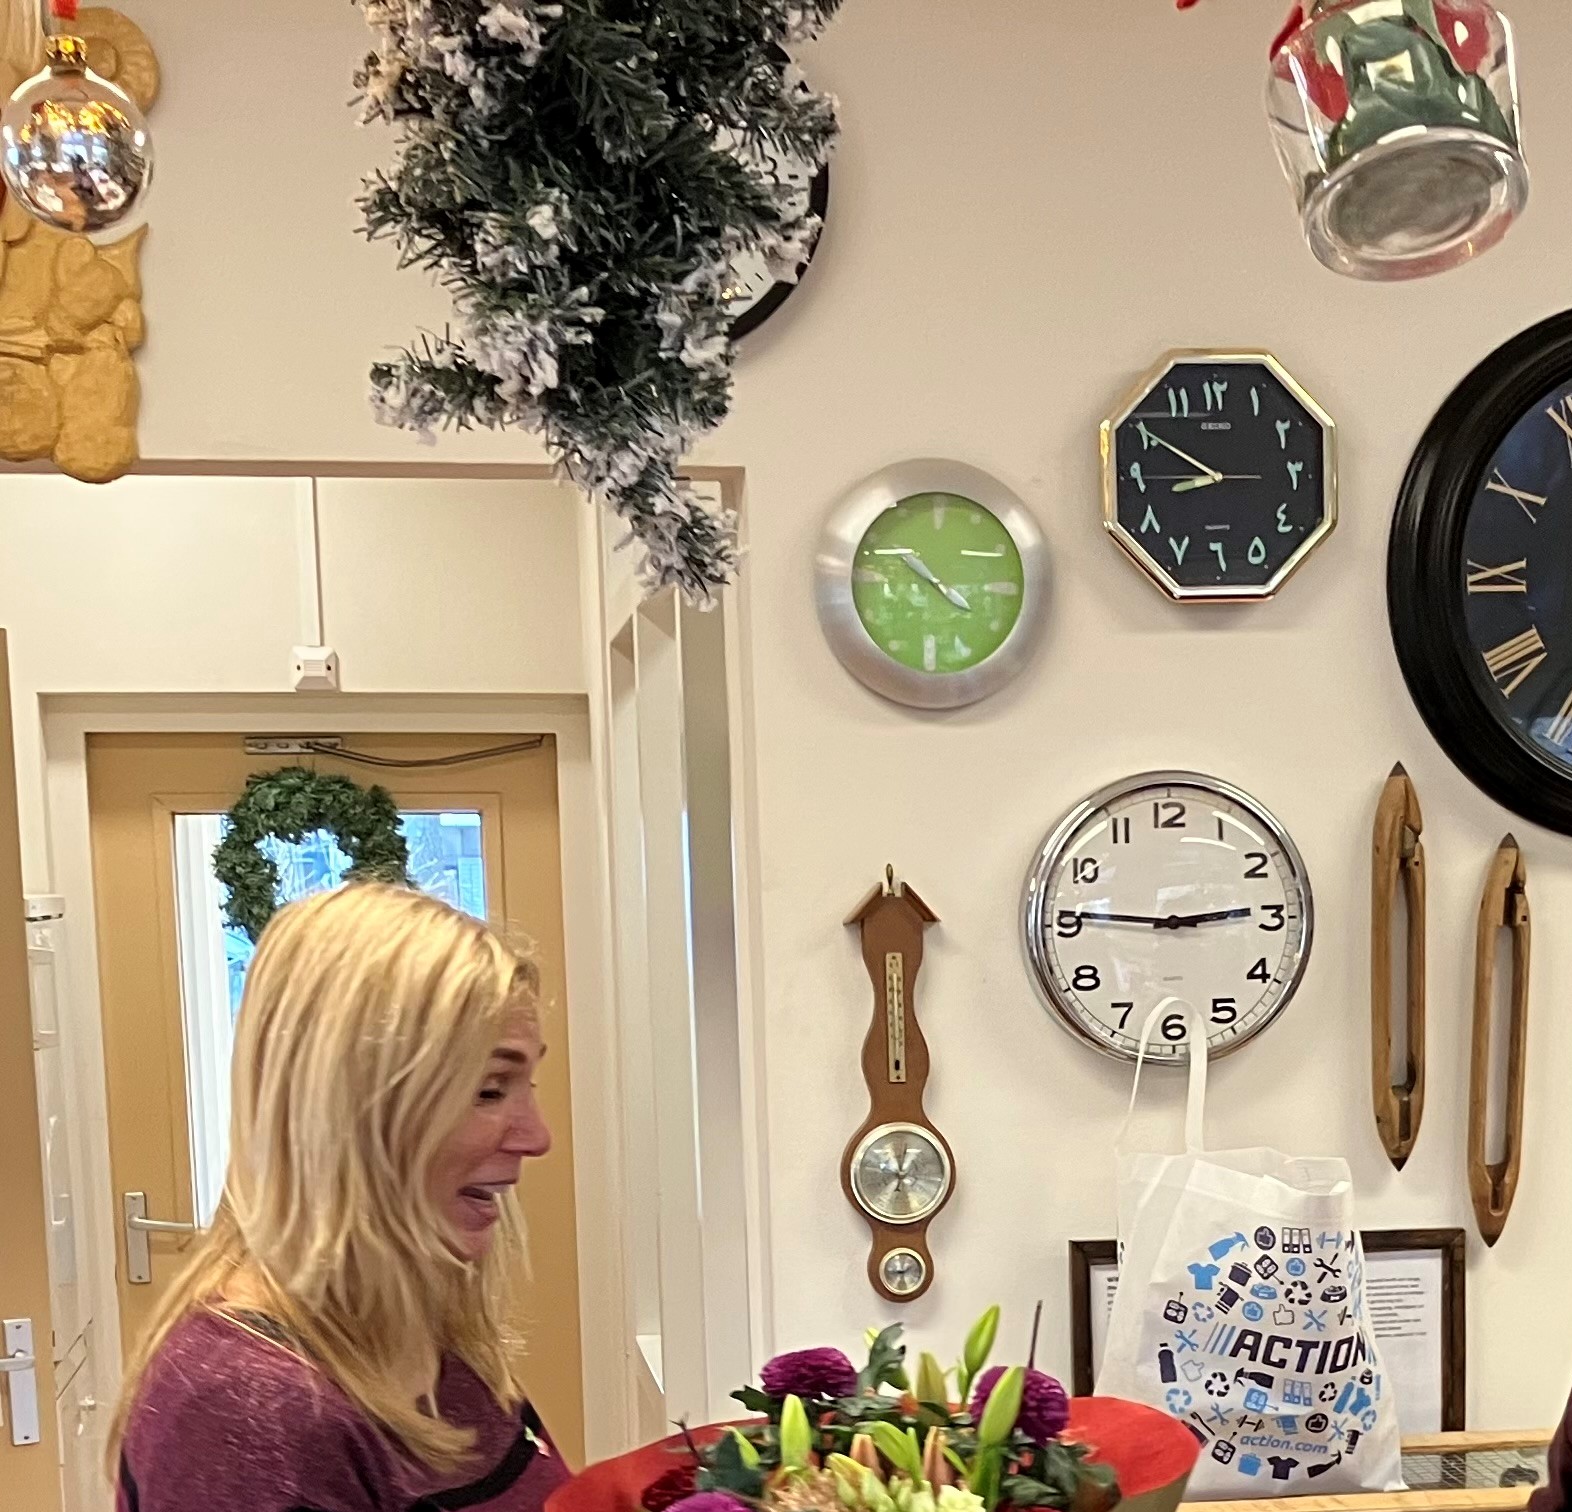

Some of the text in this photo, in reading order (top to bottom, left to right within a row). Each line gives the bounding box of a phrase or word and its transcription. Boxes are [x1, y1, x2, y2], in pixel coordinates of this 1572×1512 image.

[1275, 419, 1291, 451] ٢
[1286, 460, 1303, 490] ٣
[1485, 467, 1549, 524] X
[1140, 504, 1161, 534] ٨
[1275, 503, 1293, 534] ٤
[1169, 536, 1190, 566] ٧
[1209, 542, 1228, 572] ٦
[1247, 536, 1267, 565] ٥
[1466, 557, 1528, 595] IX
[1153, 802, 1187, 829] 12
[1217, 816, 1224, 841] 1
[1111, 817, 1130, 844] 11
[1072, 857, 1100, 884] 10
[1243, 852, 1269, 879] 2
[1056, 909, 1083, 938] 9
[1258, 904, 1285, 932] 3
[1072, 965, 1101, 991] 8
[1246, 958, 1271, 984] 4
[1110, 1002, 1134, 1029] 7
[1210, 998, 1237, 1024] 5
[1161, 1014, 1187, 1041] 6
[1239, 1434, 1328, 1455] action.com
